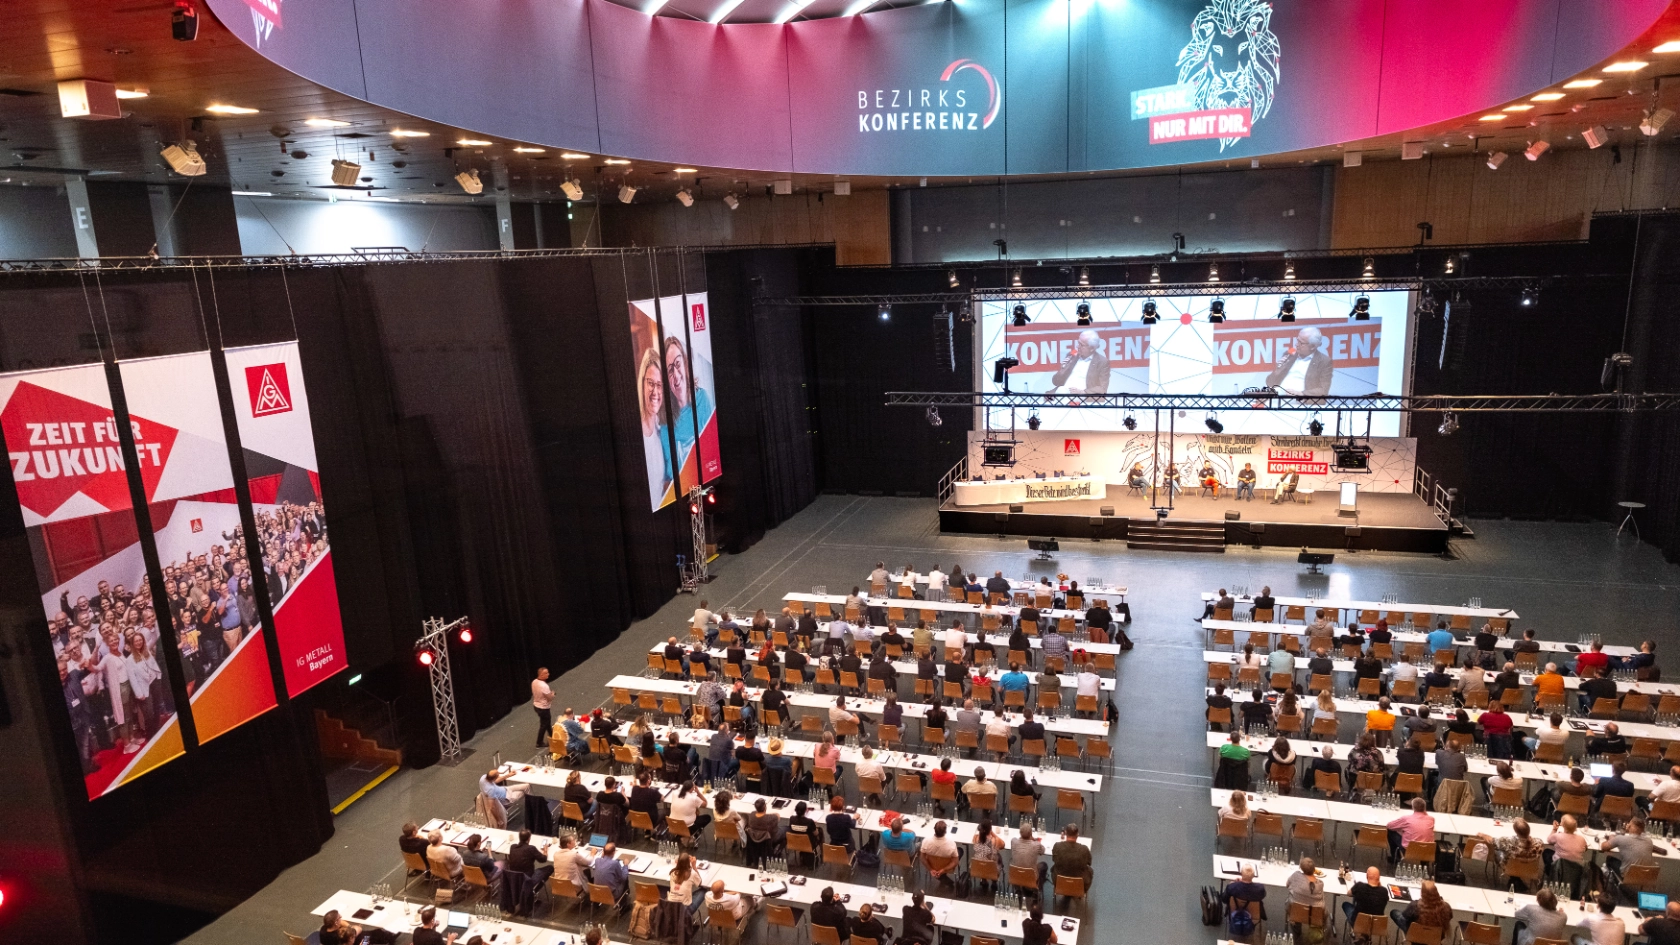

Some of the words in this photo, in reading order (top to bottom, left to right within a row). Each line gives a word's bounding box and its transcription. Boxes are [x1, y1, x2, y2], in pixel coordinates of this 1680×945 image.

[858, 89, 967, 109] BEZIRKS
[1135, 89, 1192, 115] STARK.
[859, 112, 979, 132] KONFERENZ
[1153, 118, 1187, 140] NUR
[1188, 115, 1217, 136] MIT
[1218, 113, 1249, 134] DIR.
[75, 206, 89, 229] E
[501, 218, 509, 233] F
[26, 421, 87, 446] ZEIT
[92, 416, 143, 445] FÜR
[8, 442, 162, 482] ZUKUNFT
[1270, 450, 1312, 459] BEZIRKS
[1270, 463, 1327, 473] KONERENZ
[296, 656, 305, 668] IG
[306, 643, 333, 663] METALL
[309, 654, 334, 672] Bayern
